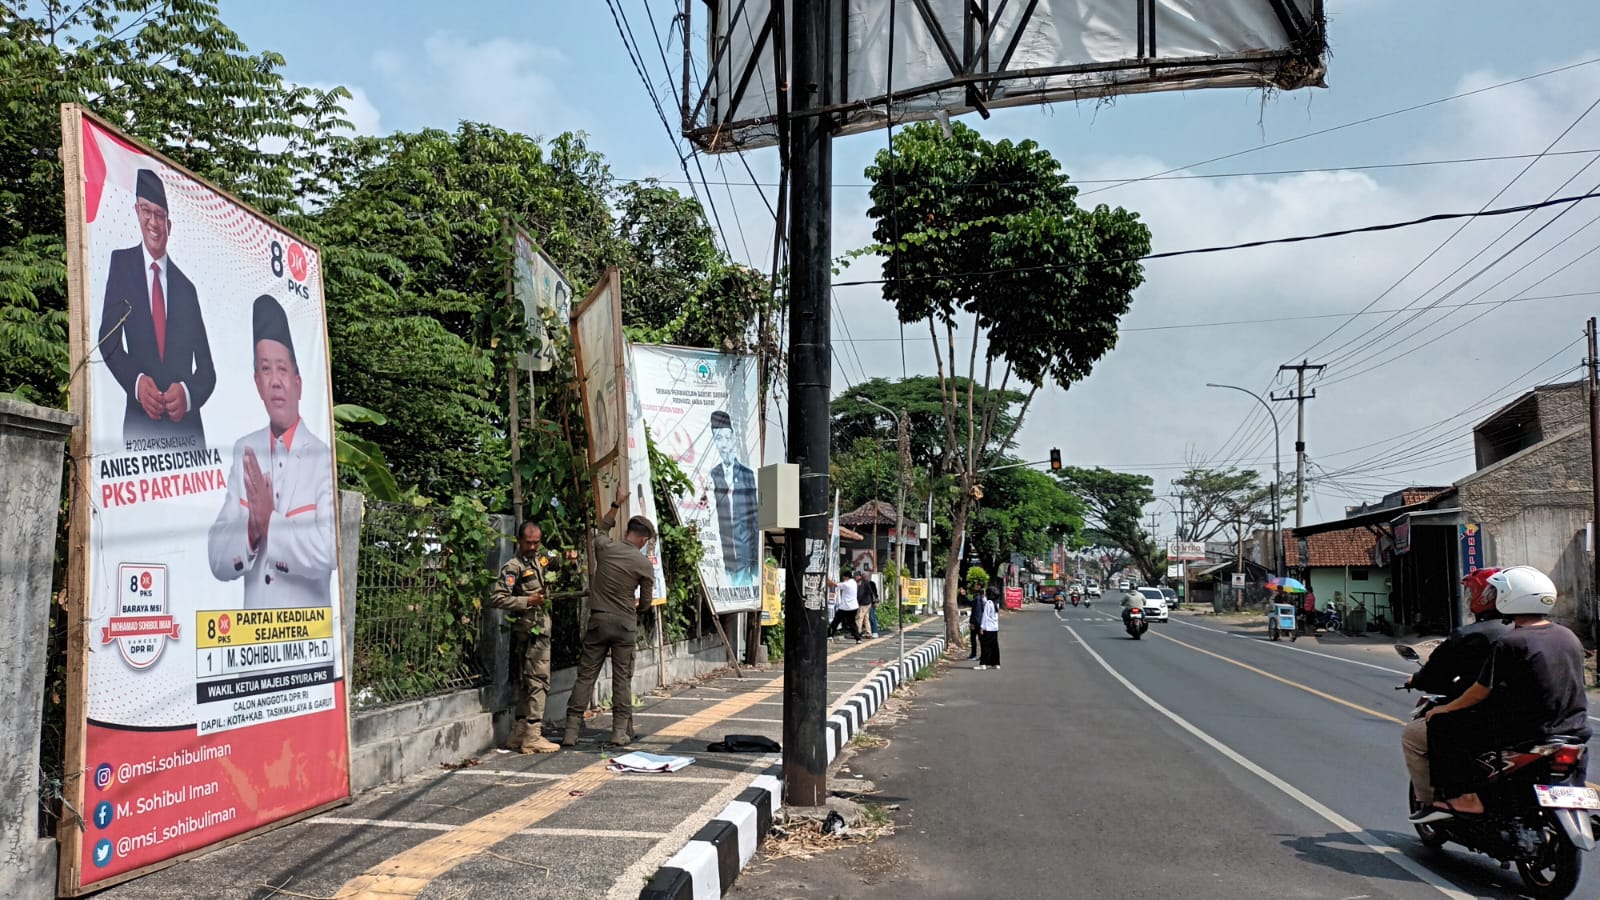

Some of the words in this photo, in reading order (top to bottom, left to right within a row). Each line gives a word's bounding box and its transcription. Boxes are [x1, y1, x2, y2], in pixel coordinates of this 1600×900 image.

[271, 240, 283, 278] 8
[288, 279, 310, 300] PKS
[126, 434, 196, 452] #2024PKSMENANG
[101, 456, 140, 479] ANIES
[142, 448, 222, 473] PRESIDENNYA
[102, 480, 137, 508] PKS
[140, 468, 226, 502] PARTAINYA
[130, 576, 138, 592] 8
[237, 612, 273, 625] PARTAI
[277, 610, 324, 623] KEADILAN
[208, 619, 216, 639] 8
[218, 636, 231, 644] PKS
[255, 626, 308, 640] SEJAHTERA
[130, 645, 145, 654] DPR
[228, 648, 238, 668] M.
[240, 645, 281, 666] SOHIBUL
[283, 642, 308, 662] IMAN,
[309, 640, 330, 657] Ph.D.
[207, 652, 212, 672] 1
[208, 684, 234, 697] WAKIL
[236, 681, 259, 693] KETUA
[261, 676, 289, 689] MAJELIS
[291, 673, 312, 685] SYURA
[314, 670, 327, 680] PKS
[233, 700, 256, 712] CALON
[257, 695, 288, 706] ANGGOTA
[289, 692, 301, 701] DPR
[302, 690, 308, 699] RI
[201, 719, 225, 731] DAPIL:
[227, 710, 264, 726] KOTA+KAB.
[266, 704, 307, 718] TASIKMALAYA
[308, 701, 313, 710] &
[314, 698, 332, 709] GARUT
[117, 742, 232, 784] @msi.sohibuliman
[117, 803, 133, 820] M.
[136, 786, 186, 812] Sohibul
[189, 780, 218, 800] Iman
[116, 806, 236, 858] @msi_sohibuliman
